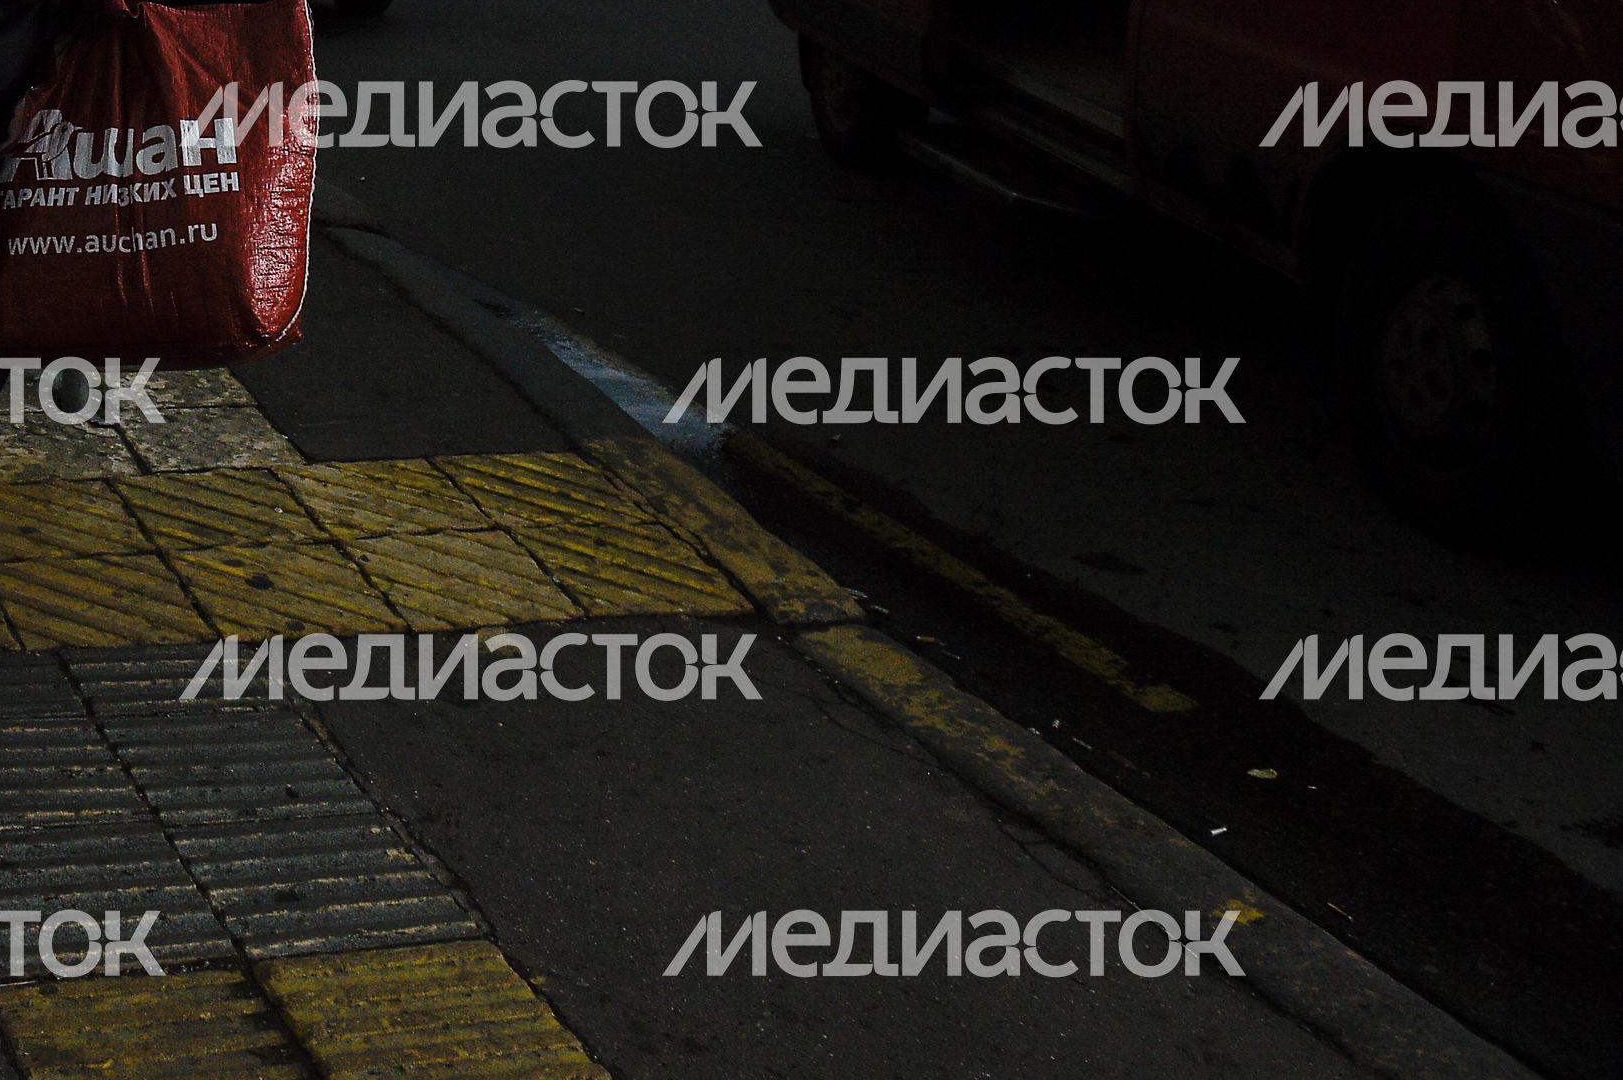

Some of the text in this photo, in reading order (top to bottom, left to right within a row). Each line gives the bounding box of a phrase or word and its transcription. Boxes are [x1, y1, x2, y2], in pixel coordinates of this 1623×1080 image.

[84, 177, 177, 208] НИЗКИХ
[183, 171, 240, 198] ЦЕН
[7, 222, 218, 256] www.auchan.ru
